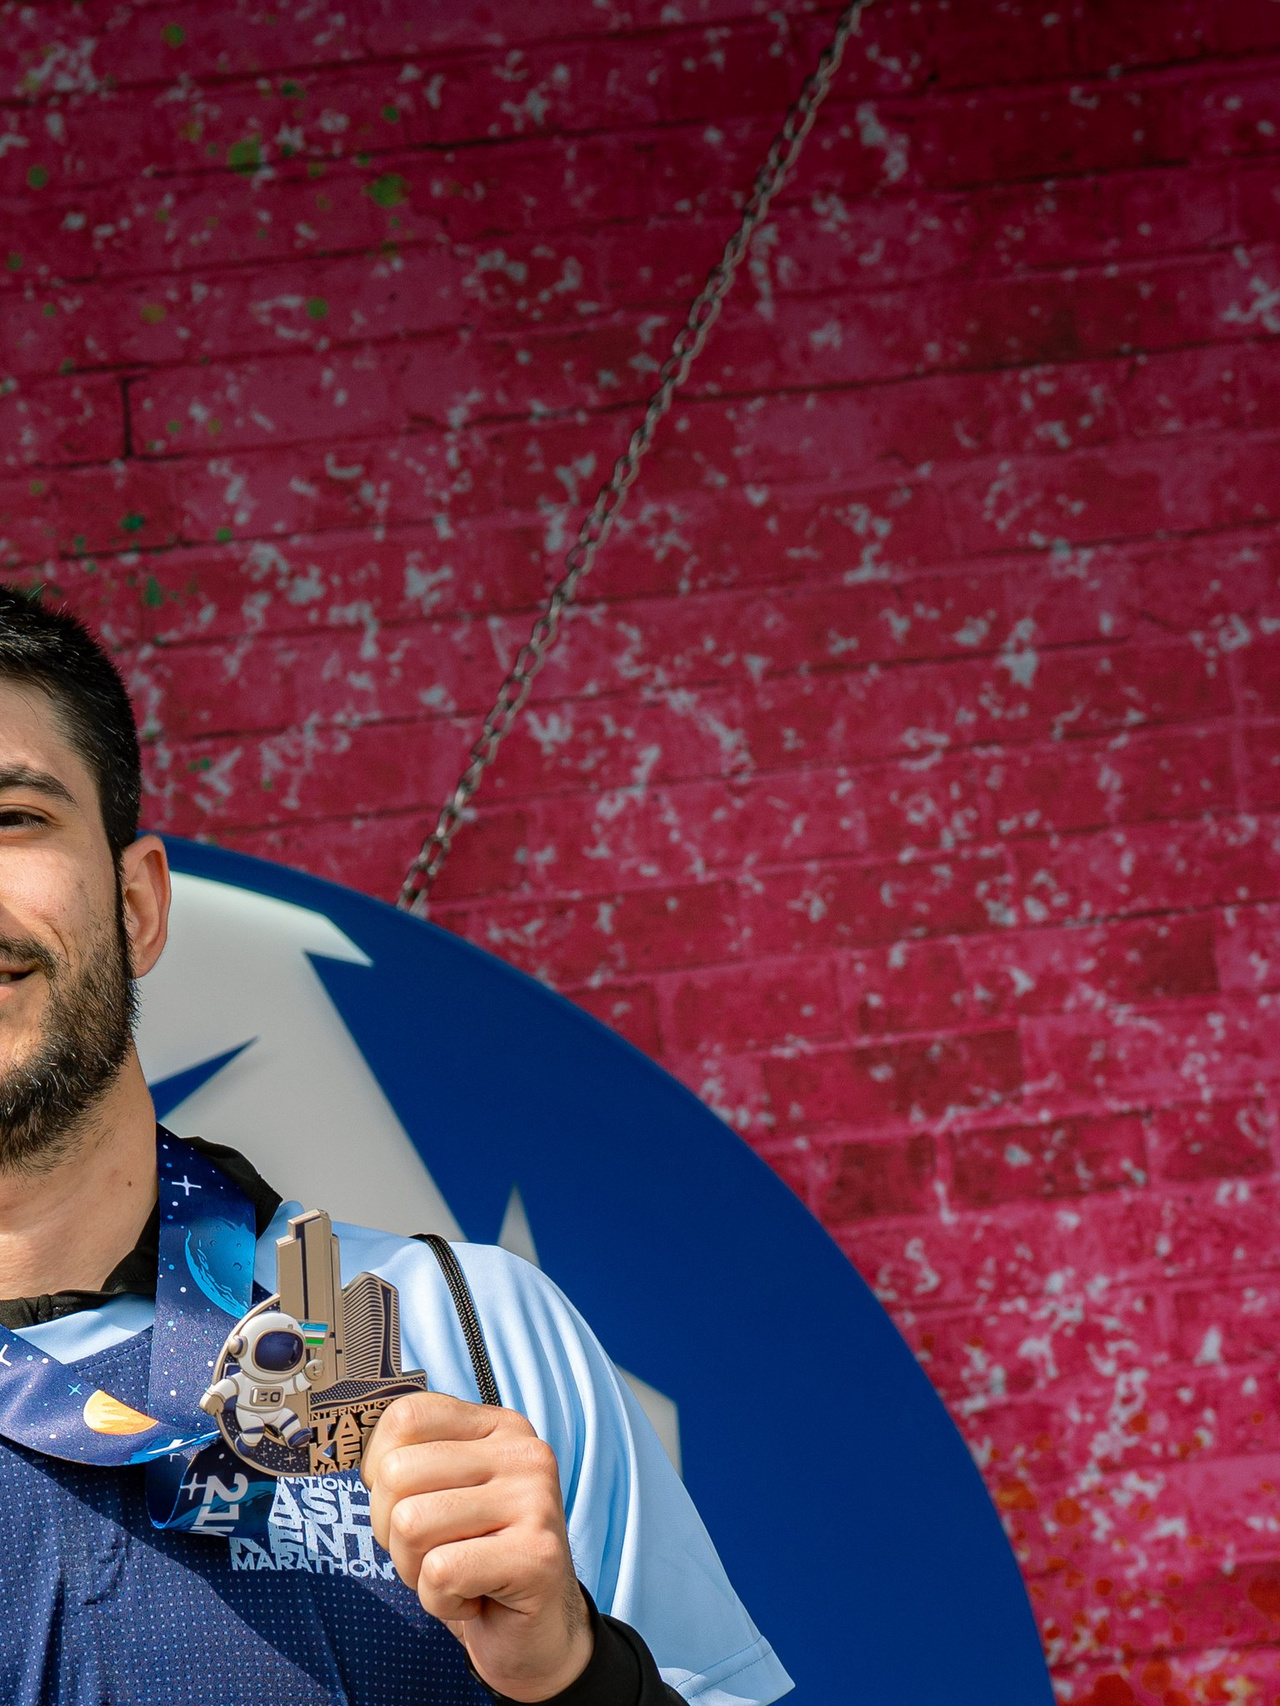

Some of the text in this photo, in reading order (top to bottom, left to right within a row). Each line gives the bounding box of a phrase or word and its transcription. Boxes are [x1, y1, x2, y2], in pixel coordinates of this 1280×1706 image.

[309, 1409, 383, 1443] TAS
[269, 1482, 372, 1526] ASH
[232, 1549, 388, 1580] MARATHON
